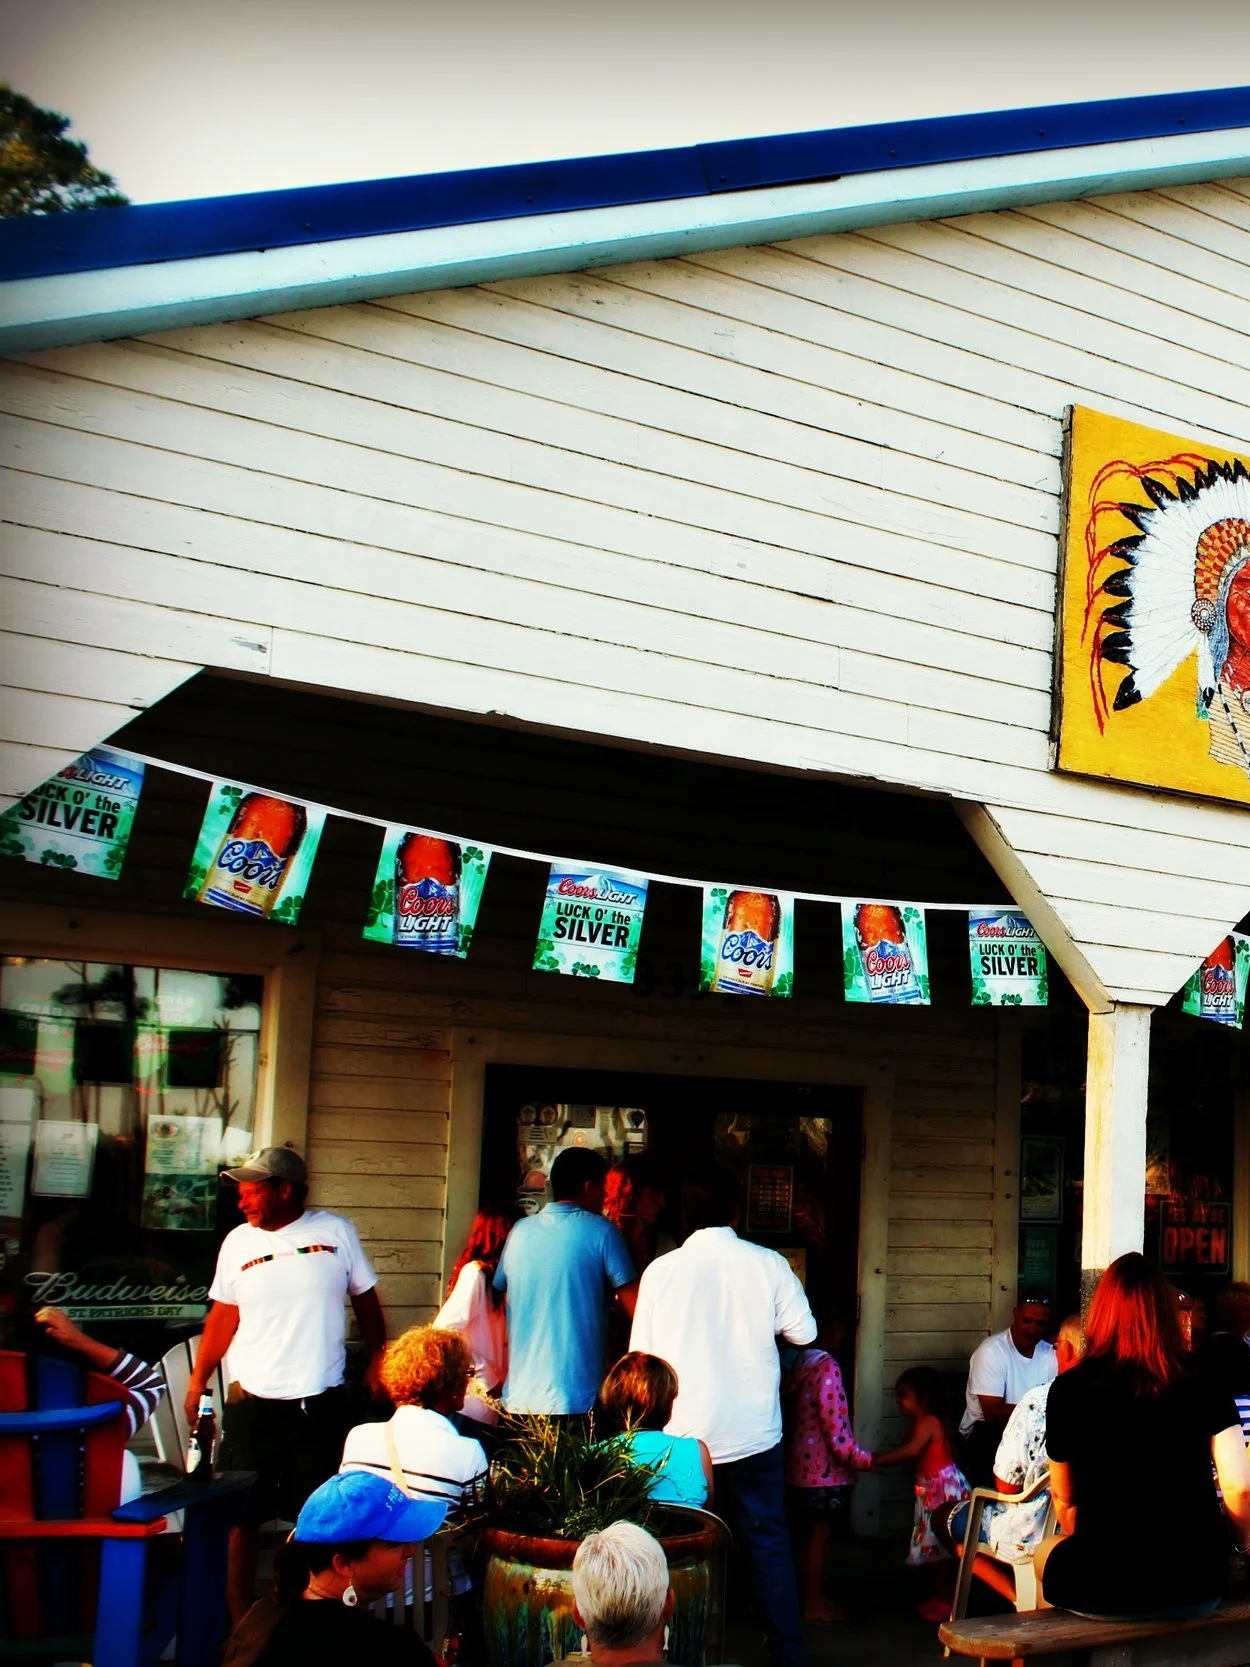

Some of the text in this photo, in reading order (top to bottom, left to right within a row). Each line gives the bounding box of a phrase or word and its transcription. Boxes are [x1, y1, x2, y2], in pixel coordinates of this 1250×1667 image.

[74, 767, 130, 789] LIGHT
[33, 782, 68, 802] UCK
[95, 795, 121, 813] the
[18, 796, 118, 839] SILVER
[217, 840, 284, 890] Coors
[399, 886, 455, 916] Coors
[558, 878, 637, 904] Coors LIGHT
[400, 916, 453, 932] LIGHT
[556, 902, 591, 920] LUCK
[612, 910, 631, 925] the
[553, 917, 630, 948] SILVER
[977, 921, 1006, 937] Coors
[721, 934, 772, 971] Coors
[866, 949, 910, 975] Coors
[979, 943, 1005, 956] LUCK
[1020, 944, 1037, 957] the
[980, 956, 1039, 976] SILVER
[872, 969, 911, 990] LIGHT
[1203, 972, 1234, 995] Coors
[1203, 993, 1233, 1008] LIGHT
[1163, 1226, 1227, 1265] OPEN
[23, 1271, 211, 1304] Budweise
[156, 1305, 183, 1317] DAY
